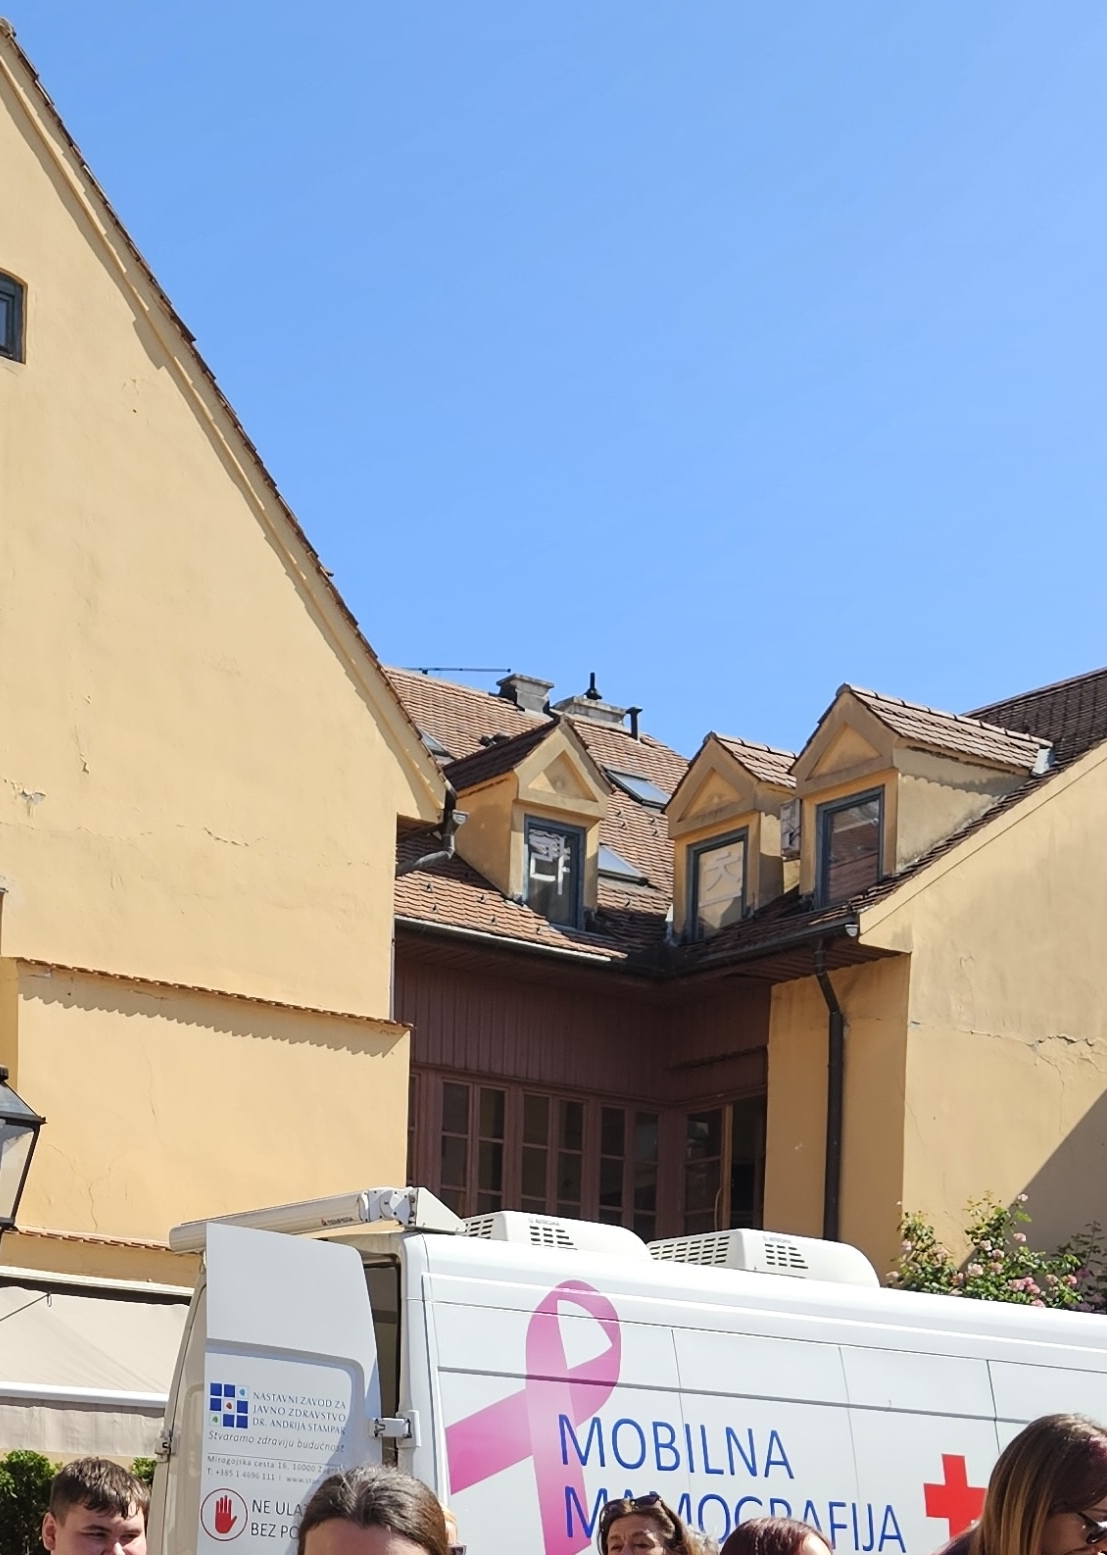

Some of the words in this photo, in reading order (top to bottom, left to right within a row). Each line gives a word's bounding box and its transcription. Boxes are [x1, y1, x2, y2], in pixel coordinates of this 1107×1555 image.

[253, 1391, 298, 1405] NASTAVNI
[300, 1396, 333, 1408] ZAVOD
[334, 1400, 347, 1410] ZA
[252, 1404, 286, 1416] JAVNO
[288, 1408, 347, 1422] ZDRAVSTVO
[252, 1417, 267, 1427] DR.
[270, 1419, 306, 1431] ANDRIJA
[208, 1430, 255, 1444] Stvaramo
[256, 1435, 294, 1449] zdraviju
[558, 1413, 795, 1480] MOBILNA
[207, 1455, 252, 1468] Mirogojska
[254, 1460, 275, 1469] cesta
[251, 1499, 271, 1515] NE
[275, 1501, 306, 1517] ULA
[250, 1522, 277, 1538] BEZ
